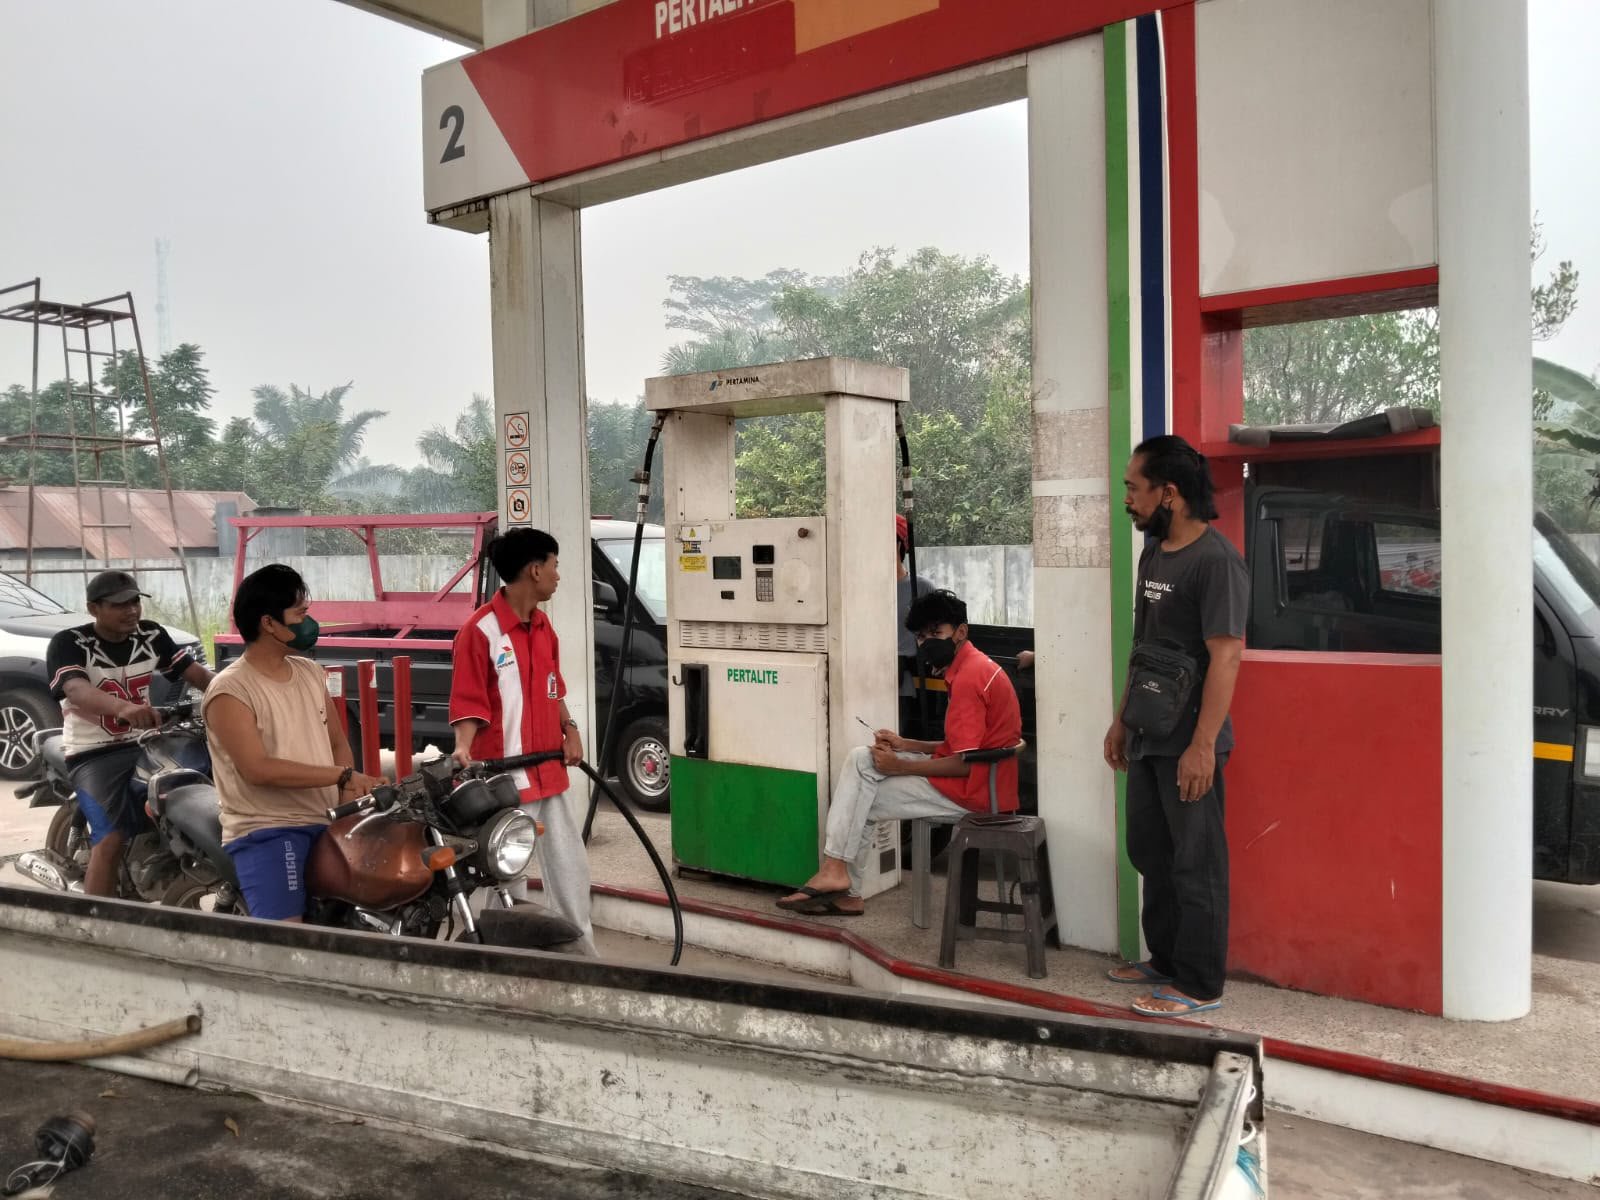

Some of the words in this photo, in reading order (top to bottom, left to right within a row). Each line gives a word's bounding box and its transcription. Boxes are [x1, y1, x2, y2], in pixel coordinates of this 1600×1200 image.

[655, 0, 754, 39] PERTA
[439, 105, 466, 163] 2
[726, 376, 760, 386] PERTAMINA
[727, 668, 778, 685] PERTALITE
